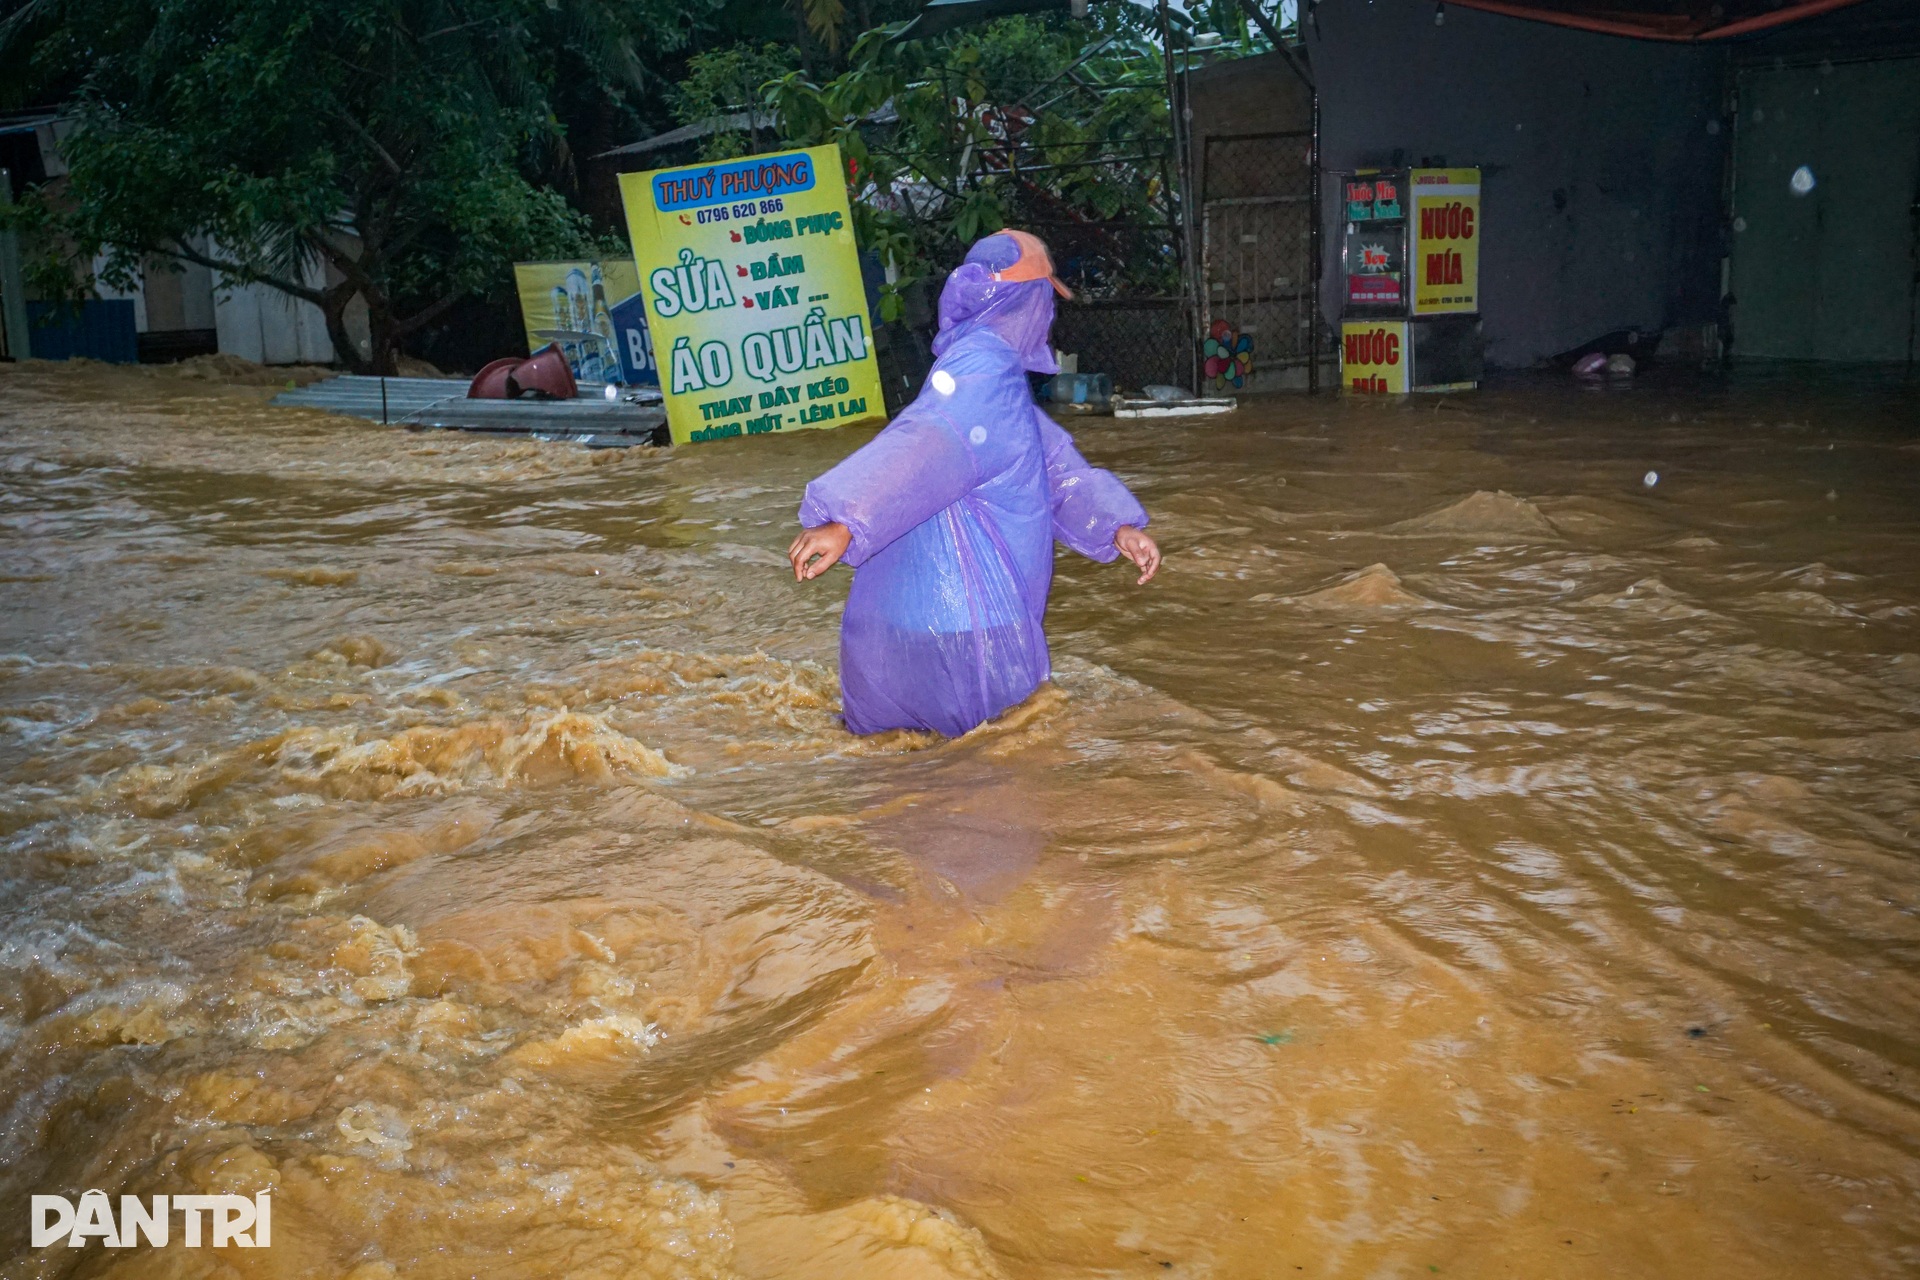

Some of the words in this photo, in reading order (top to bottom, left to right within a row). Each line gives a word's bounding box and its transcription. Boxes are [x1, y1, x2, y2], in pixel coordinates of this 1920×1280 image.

[659, 169, 716, 205] THUÝ
[721, 161, 808, 195] PHƯỢNG
[696, 206, 729, 224] 0796
[733, 202, 757, 219] 620
[760, 198, 784, 215] 866
[797, 211, 844, 236] PHỤC
[1421, 202, 1475, 240] NƯỚC
[1364, 249, 1388, 265] New
[1426, 248, 1463, 285] MÍA
[650, 248, 736, 318] SỬA
[755, 285, 800, 310] VÁY
[671, 336, 733, 395] ÁO
[742, 307, 868, 383] QUẦN
[1345, 328, 1400, 365] NƯỚC
[699, 394, 753, 421] THAY
[759, 385, 801, 410] DÂY
[807, 376, 850, 401] KÉO
[746, 413, 783, 435] NÚT
[799, 404, 835, 425] LÊN
[838, 397, 867, 417] LAI
